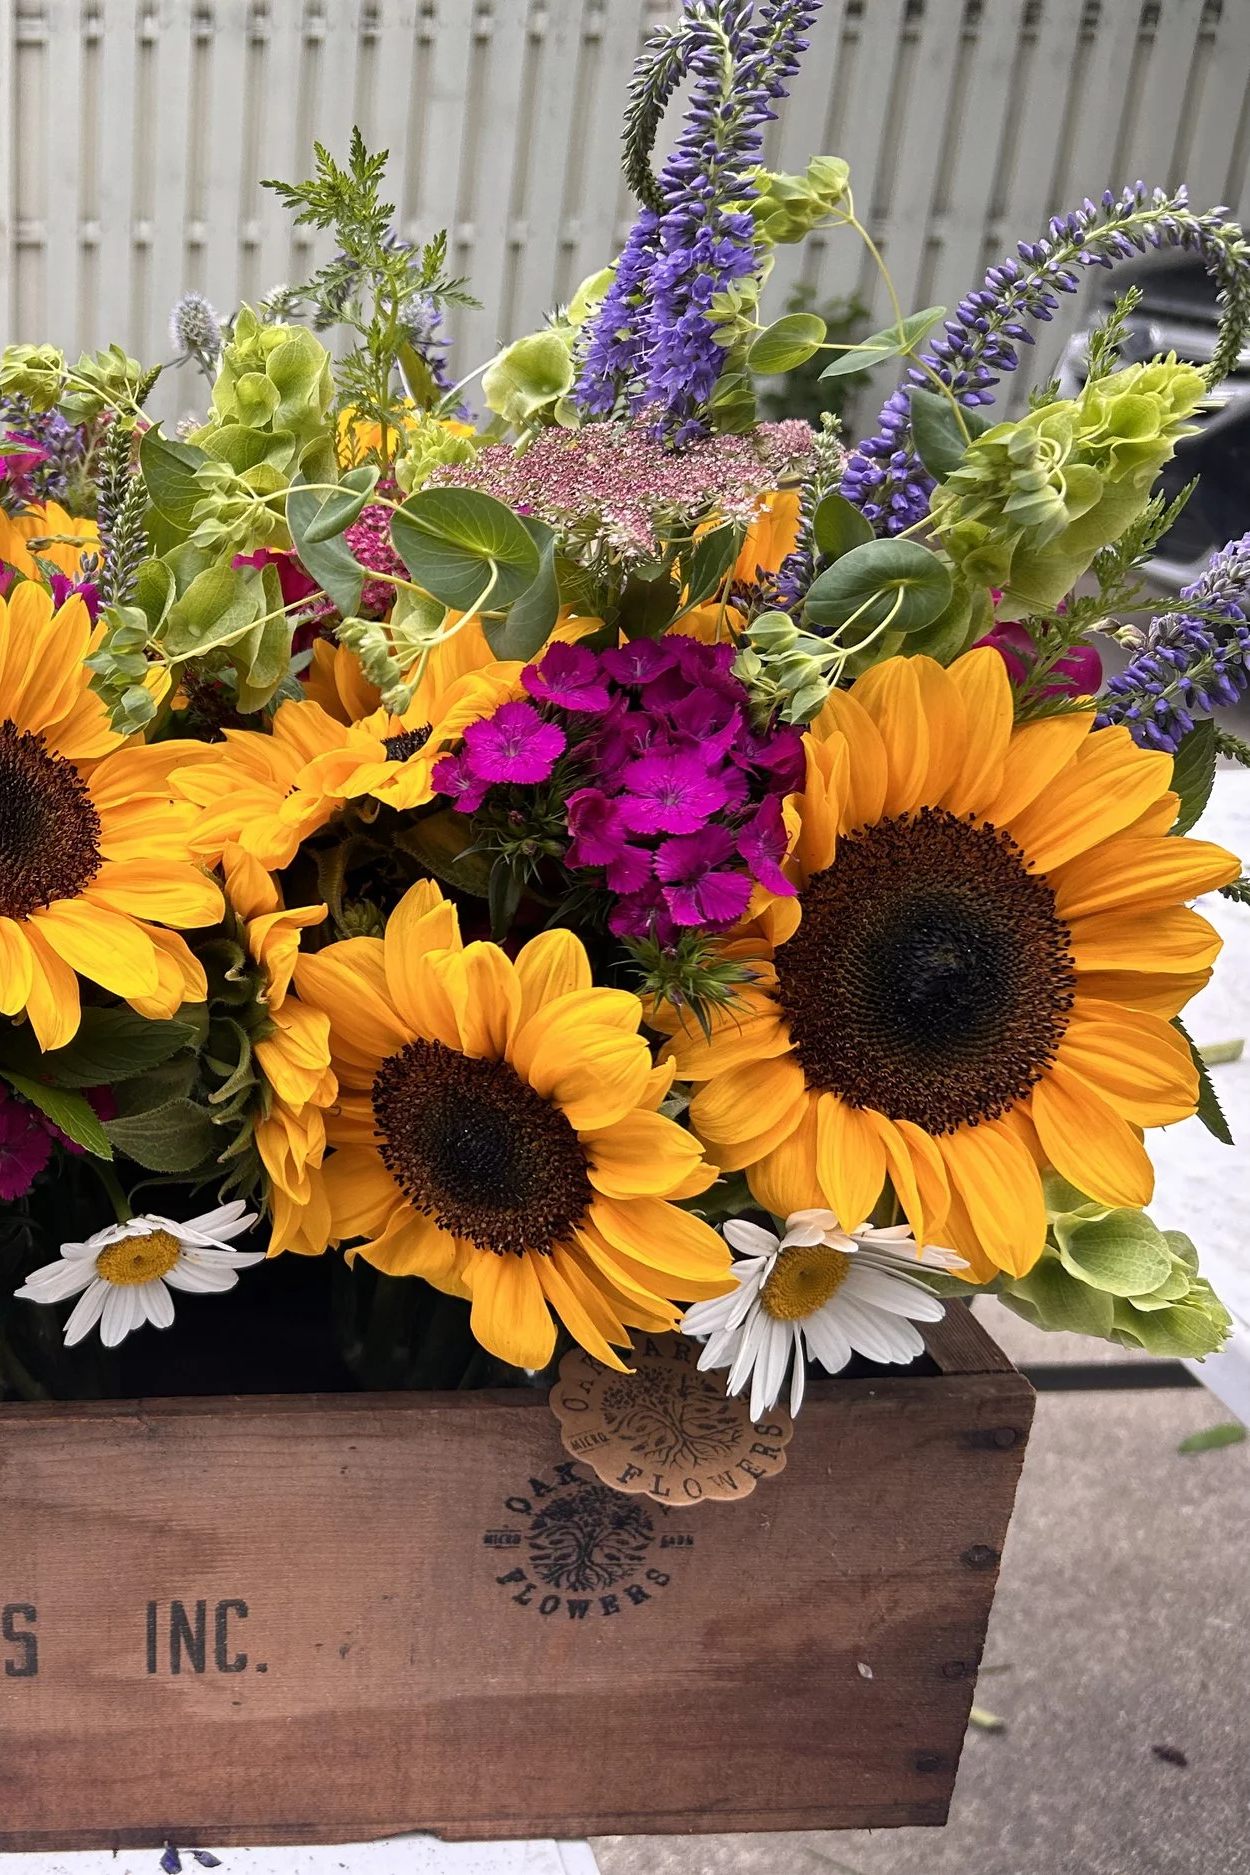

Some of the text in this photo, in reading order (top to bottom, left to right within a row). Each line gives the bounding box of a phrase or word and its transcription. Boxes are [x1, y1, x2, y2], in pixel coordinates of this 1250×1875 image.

[570, 1432, 609, 1450] MICRO
[617, 1422, 783, 1500] FLOWERS
[505, 1462, 582, 1514] OAK
[496, 1567, 670, 1619] FLOWERS
[145, 1599, 268, 1675] INC.
